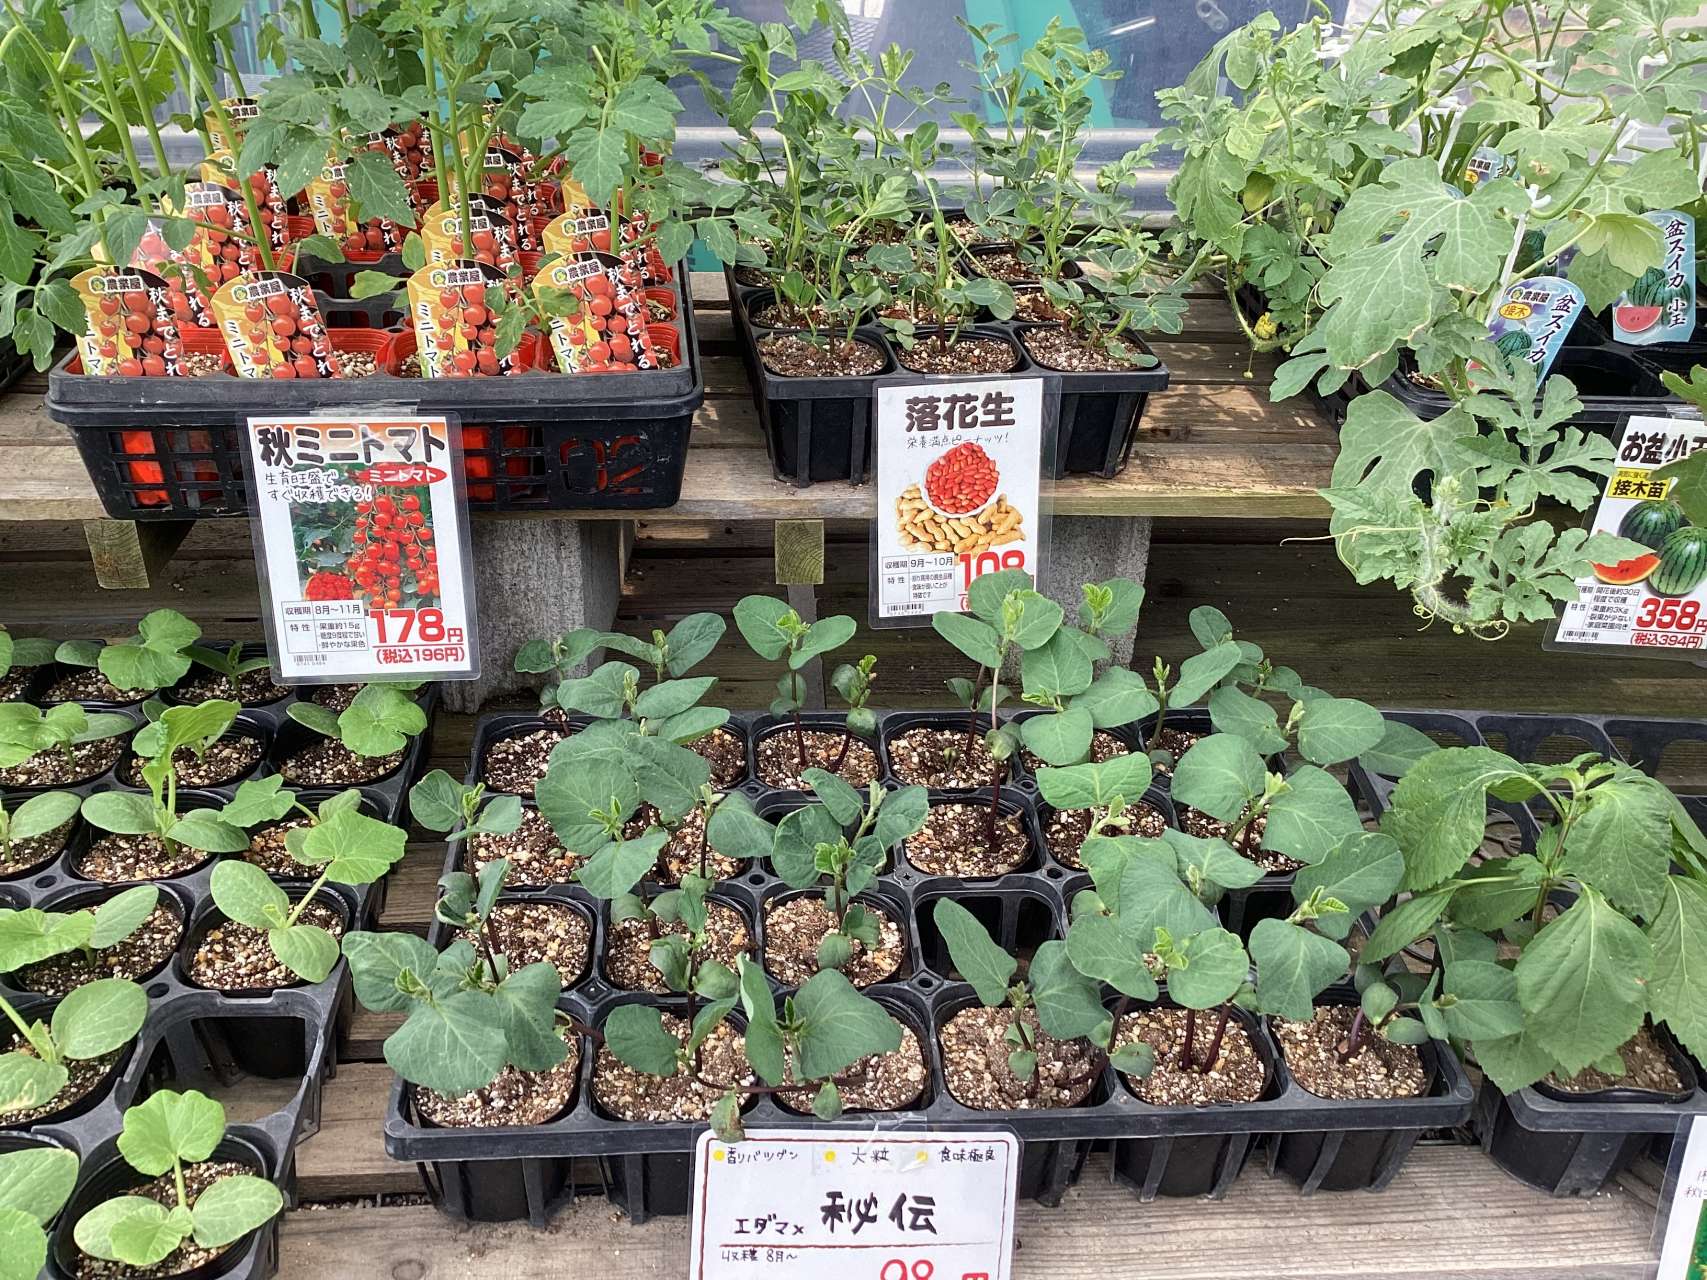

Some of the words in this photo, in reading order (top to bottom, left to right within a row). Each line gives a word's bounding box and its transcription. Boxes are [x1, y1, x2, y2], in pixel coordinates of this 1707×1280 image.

[1664, 219, 1687, 288] 盆スイカ
[1526, 294, 1577, 363] 盆スイカ
[1668, 299, 1686, 328] 小玉
[905, 391, 1016, 432] 落花生
[257, 426, 446, 466] 秋ミニトマト
[1612, 479, 1667, 499] 接木苗
[376, 646, 465, 665] (税込196円)
[819, 1191, 938, 1235] 秘伝
